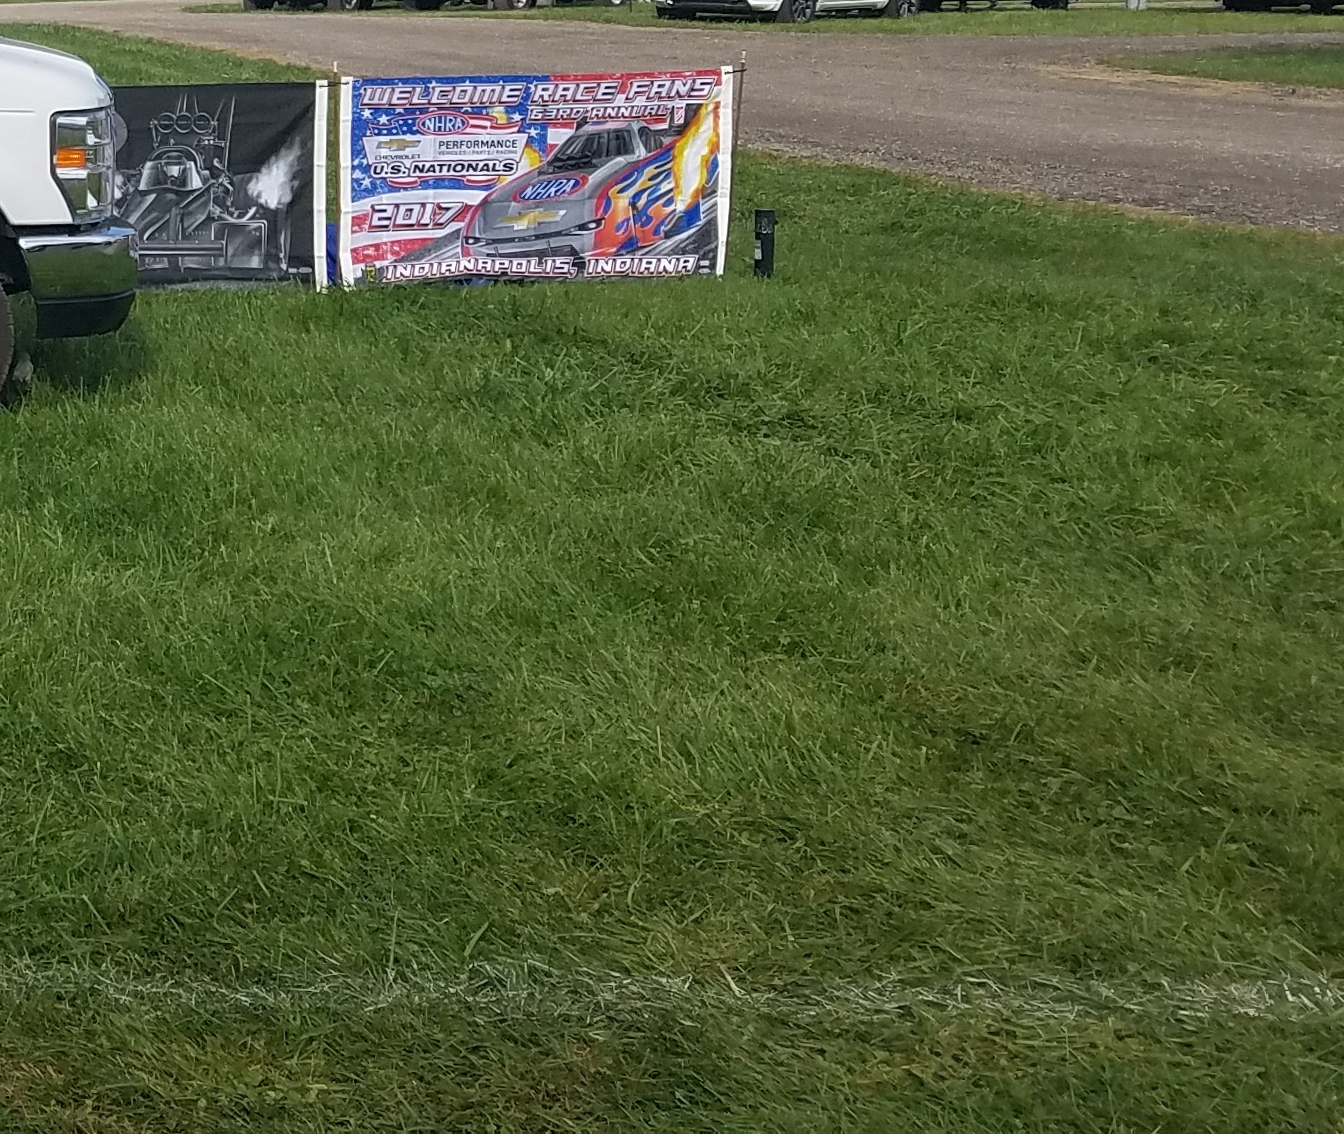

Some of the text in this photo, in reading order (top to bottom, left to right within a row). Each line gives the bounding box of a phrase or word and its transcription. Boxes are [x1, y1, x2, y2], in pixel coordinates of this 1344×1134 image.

[361, 77, 717, 107] WELCOME RACE FANS
[528, 107, 584, 123] 63RD
[588, 104, 670, 122] ANNUAL
[423, 116, 465, 133] NHRA
[438, 139, 519, 150] PERFORMANCE
[373, 162, 515, 175] U.S. NATIONALS
[520, 178, 576, 201] NHRA
[369, 202, 465, 232] 2017
[384, 255, 698, 282] INDIANAPOLIS, INDIANA
